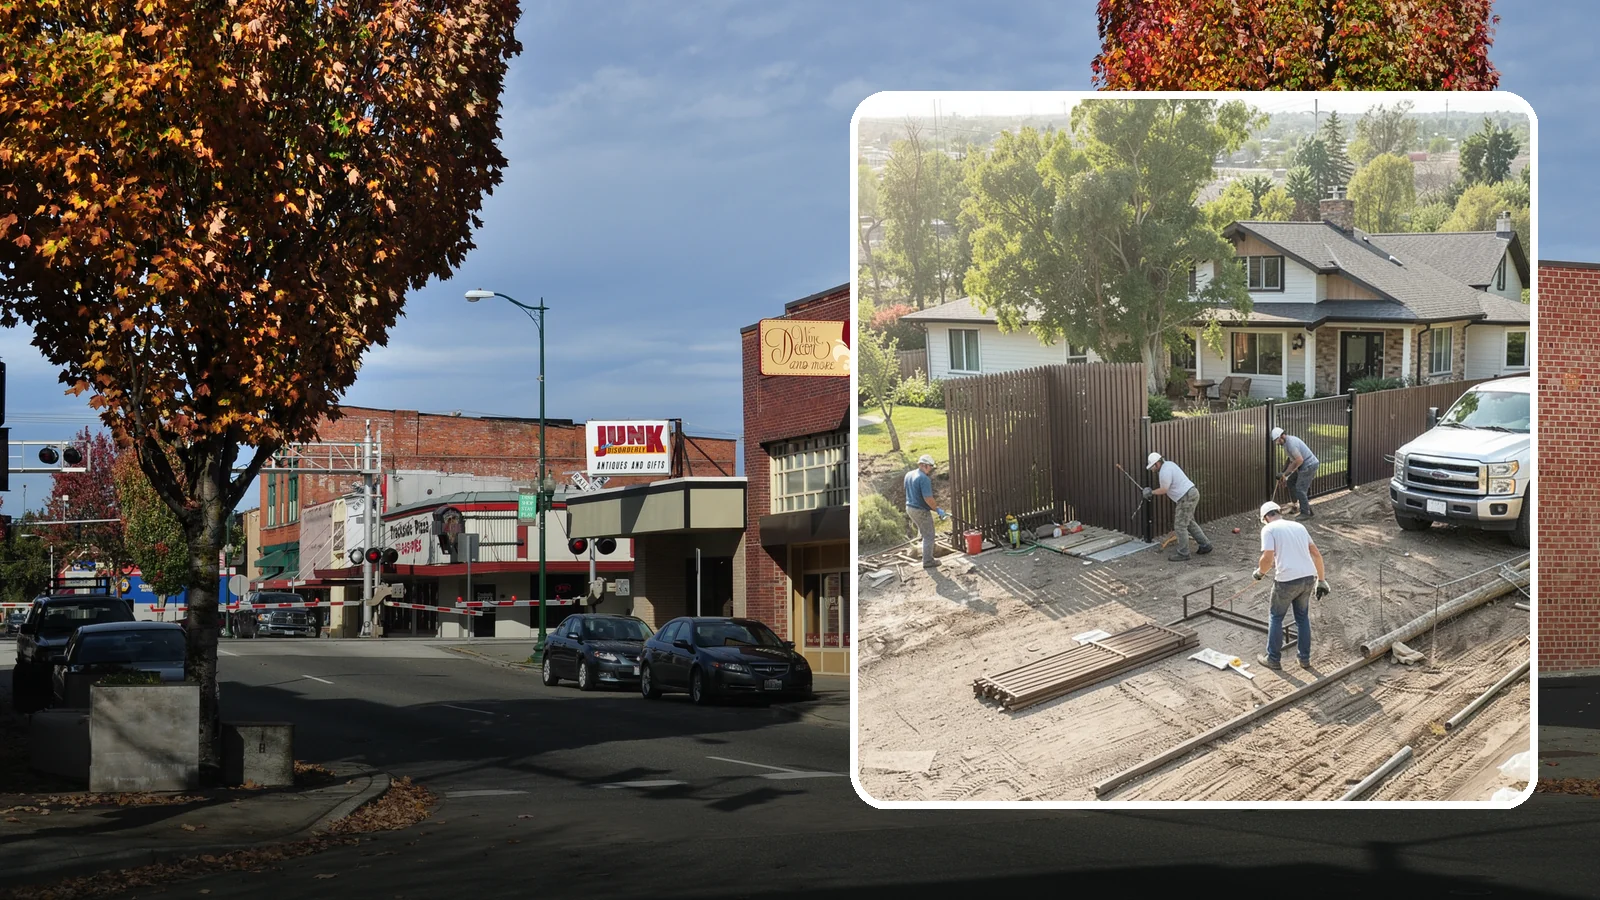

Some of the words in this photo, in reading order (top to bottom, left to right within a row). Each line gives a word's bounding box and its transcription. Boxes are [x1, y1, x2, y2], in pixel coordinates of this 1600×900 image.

[791, 325, 823, 345] Wine
[596, 425, 665, 457] JUNK
[597, 461, 628, 470] ANTIQUES
[631, 461, 644, 470] AND
[647, 460, 665, 470] GIFTS
[414, 519, 429, 535] Pizza
